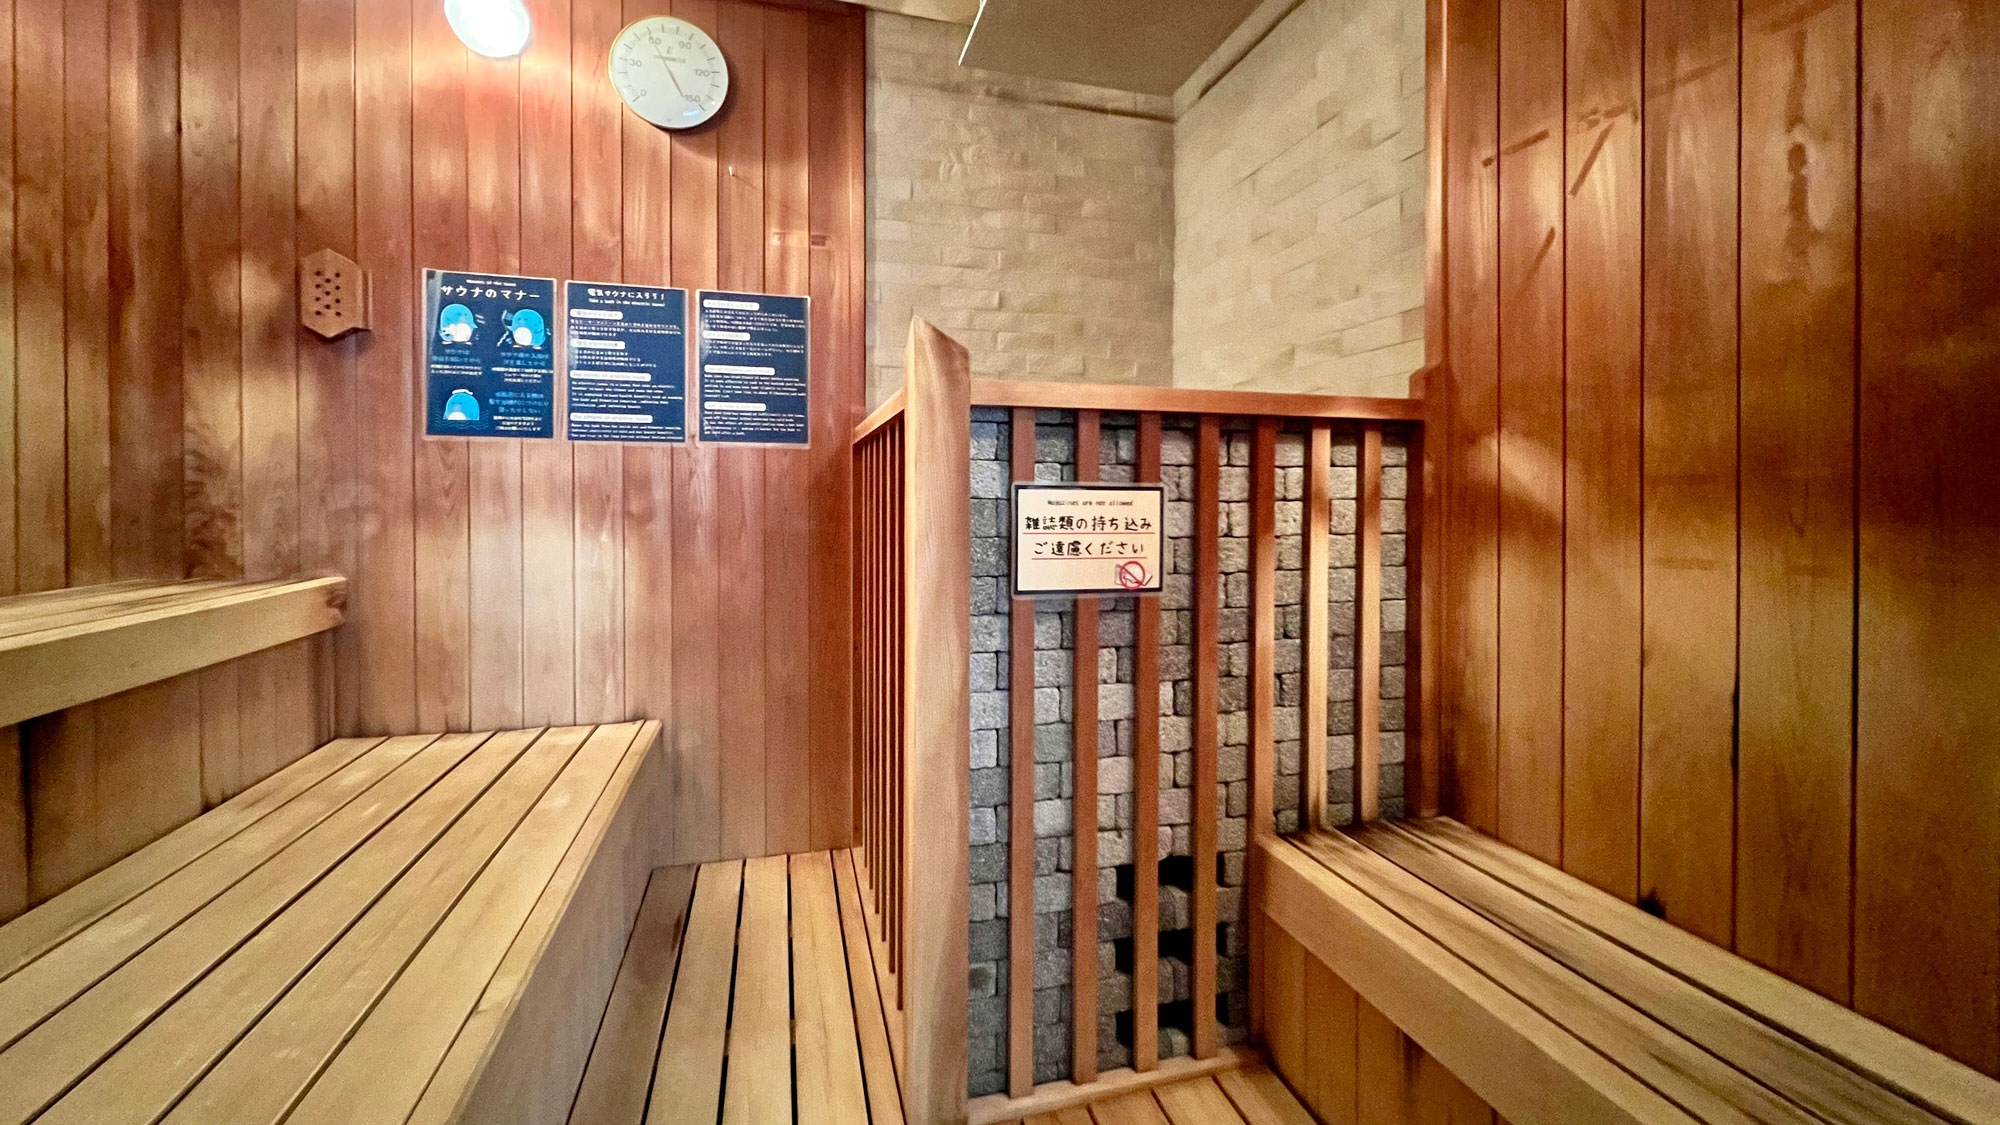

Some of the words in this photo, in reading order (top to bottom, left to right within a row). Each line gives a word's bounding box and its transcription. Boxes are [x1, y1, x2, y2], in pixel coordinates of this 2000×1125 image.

[648, 35, 662, 46] 60
[678, 40, 692, 51] 90
[629, 58, 642, 68] 30
[694, 68, 710, 78] 120
[640, 88, 647, 97] 0
[684, 94, 701, 103] 150
[440, 285, 541, 301] サウナのマナー
[1024, 515, 1152, 531] 雑誌類の持ち込み
[1034, 540, 1144, 556] ご遠慮ください
